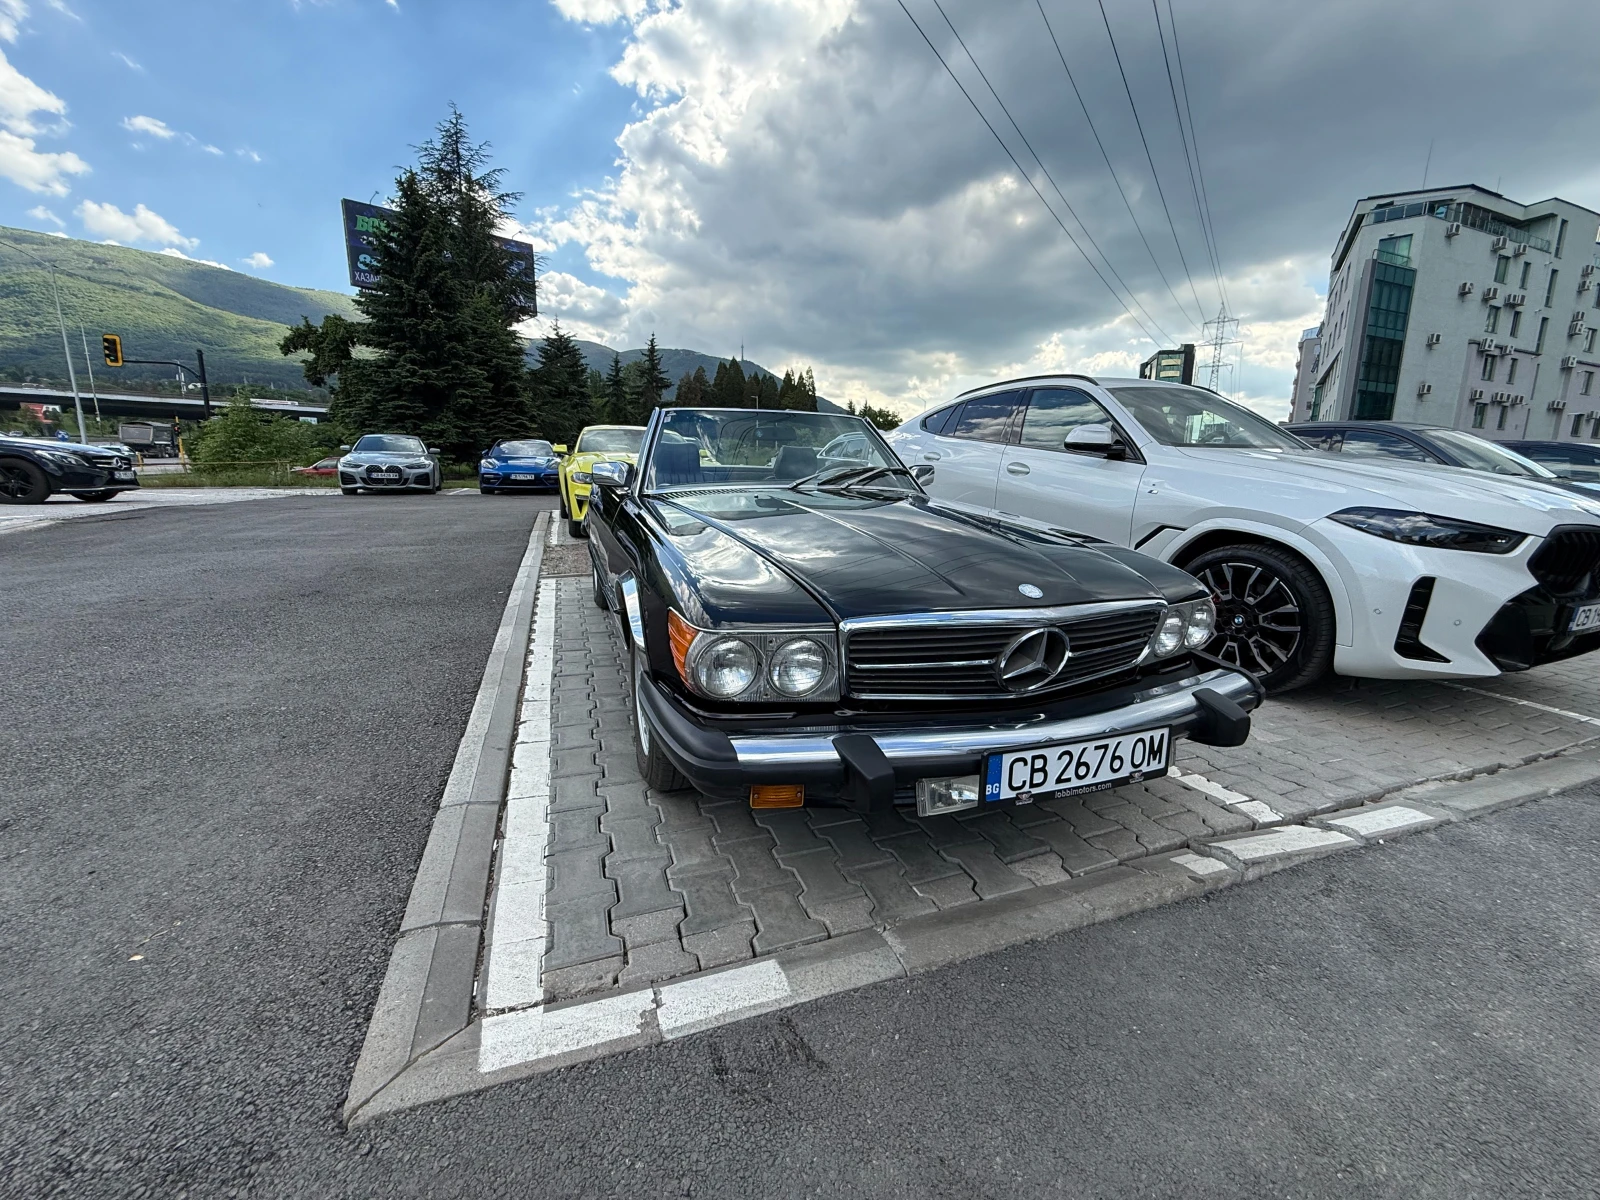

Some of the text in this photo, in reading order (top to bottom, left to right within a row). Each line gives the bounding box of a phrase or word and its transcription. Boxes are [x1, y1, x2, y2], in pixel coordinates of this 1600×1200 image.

[1575, 608, 1592, 628] CB
[985, 733, 1164, 795] BG CB 2676 OM
[1055, 782, 1112, 798] lobbimotors.com
